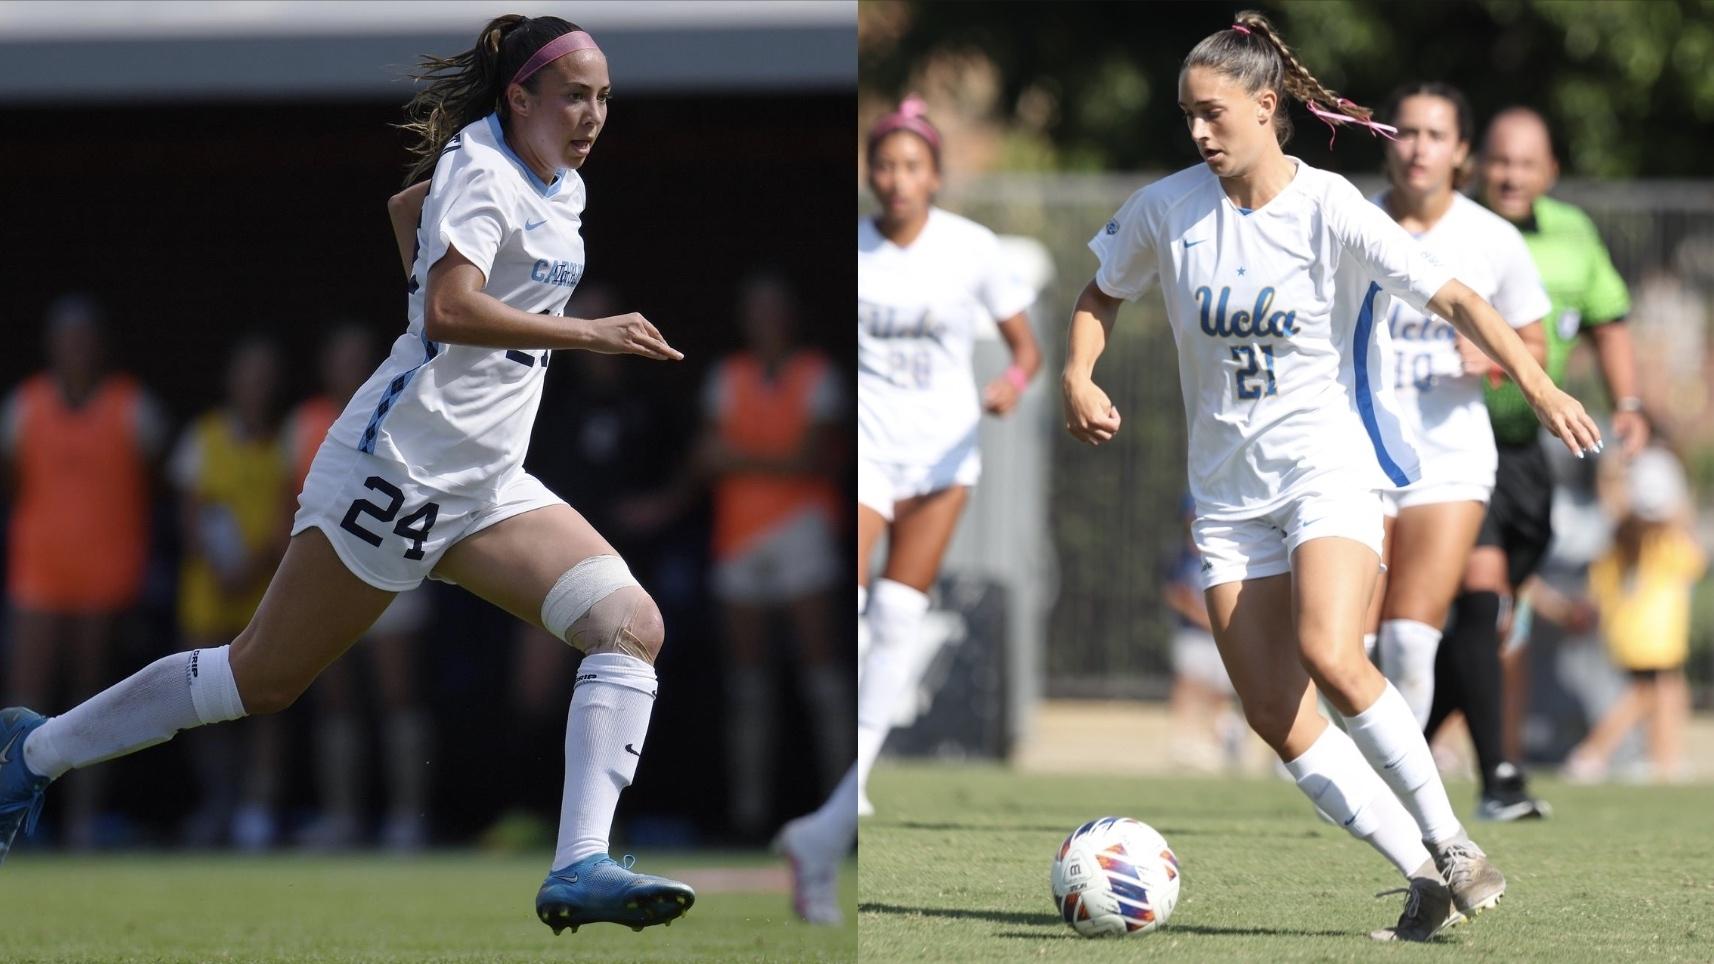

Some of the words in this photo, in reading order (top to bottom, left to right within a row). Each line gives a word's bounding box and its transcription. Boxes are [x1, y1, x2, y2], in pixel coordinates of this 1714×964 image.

[1195, 286, 1301, 338] Ucla
[1230, 344, 1279, 401] 21
[339, 475, 440, 561] 24
